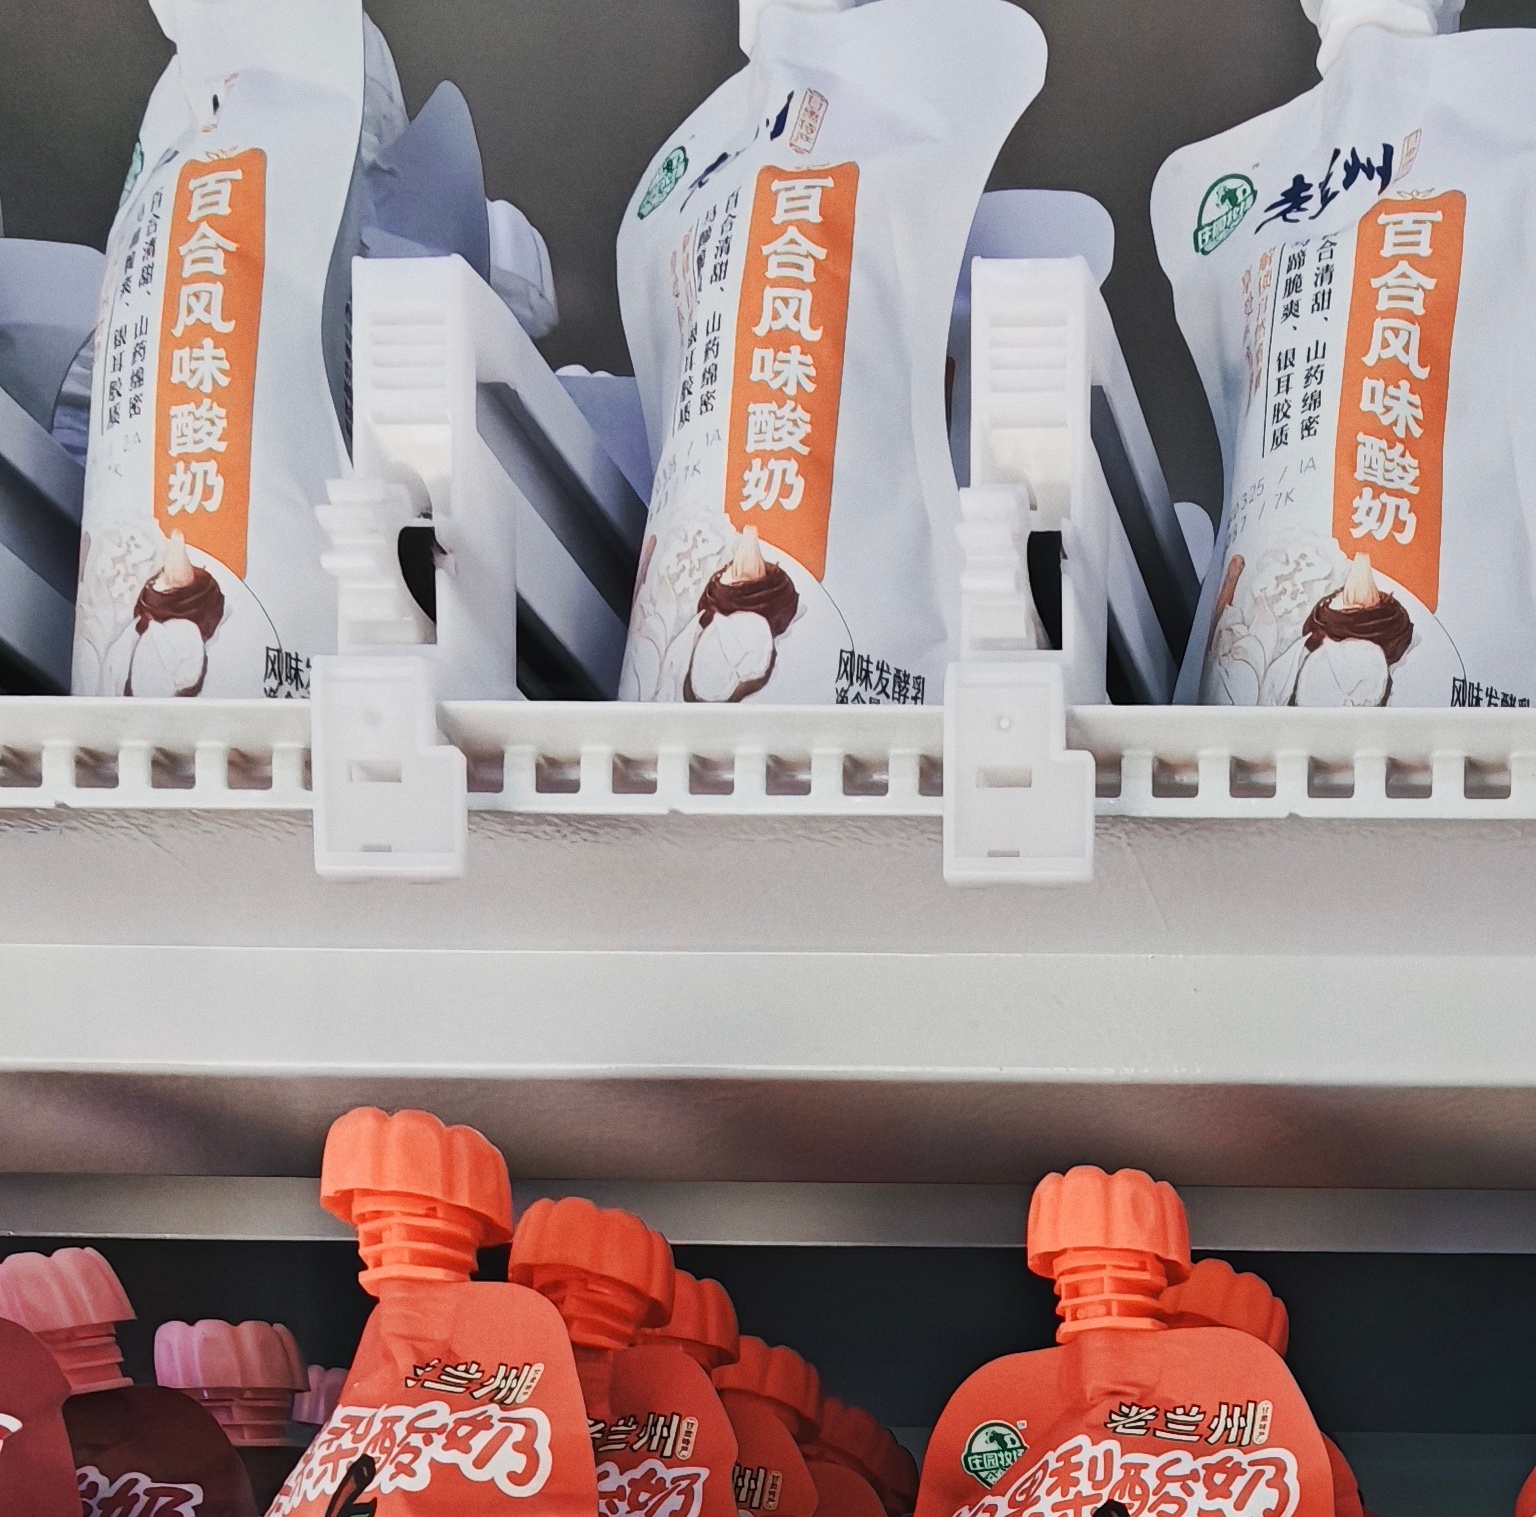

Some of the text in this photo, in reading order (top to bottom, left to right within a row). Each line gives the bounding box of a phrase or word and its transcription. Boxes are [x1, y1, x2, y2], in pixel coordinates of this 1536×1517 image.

[167, 168, 244, 516] 百合风味酸奶
[741, 177, 834, 513] 百合风味酸奶
[1270, 240, 1308, 452] 蹄脆爽、银耳胶质
[1299, 237, 1338, 441] 合清甜、山药绵密
[1350, 208, 1444, 546] 百合风味酸奶
[836, 648, 925, 705] 风味发酵乳
[1106, 1401, 1258, 1447] 老兰州
